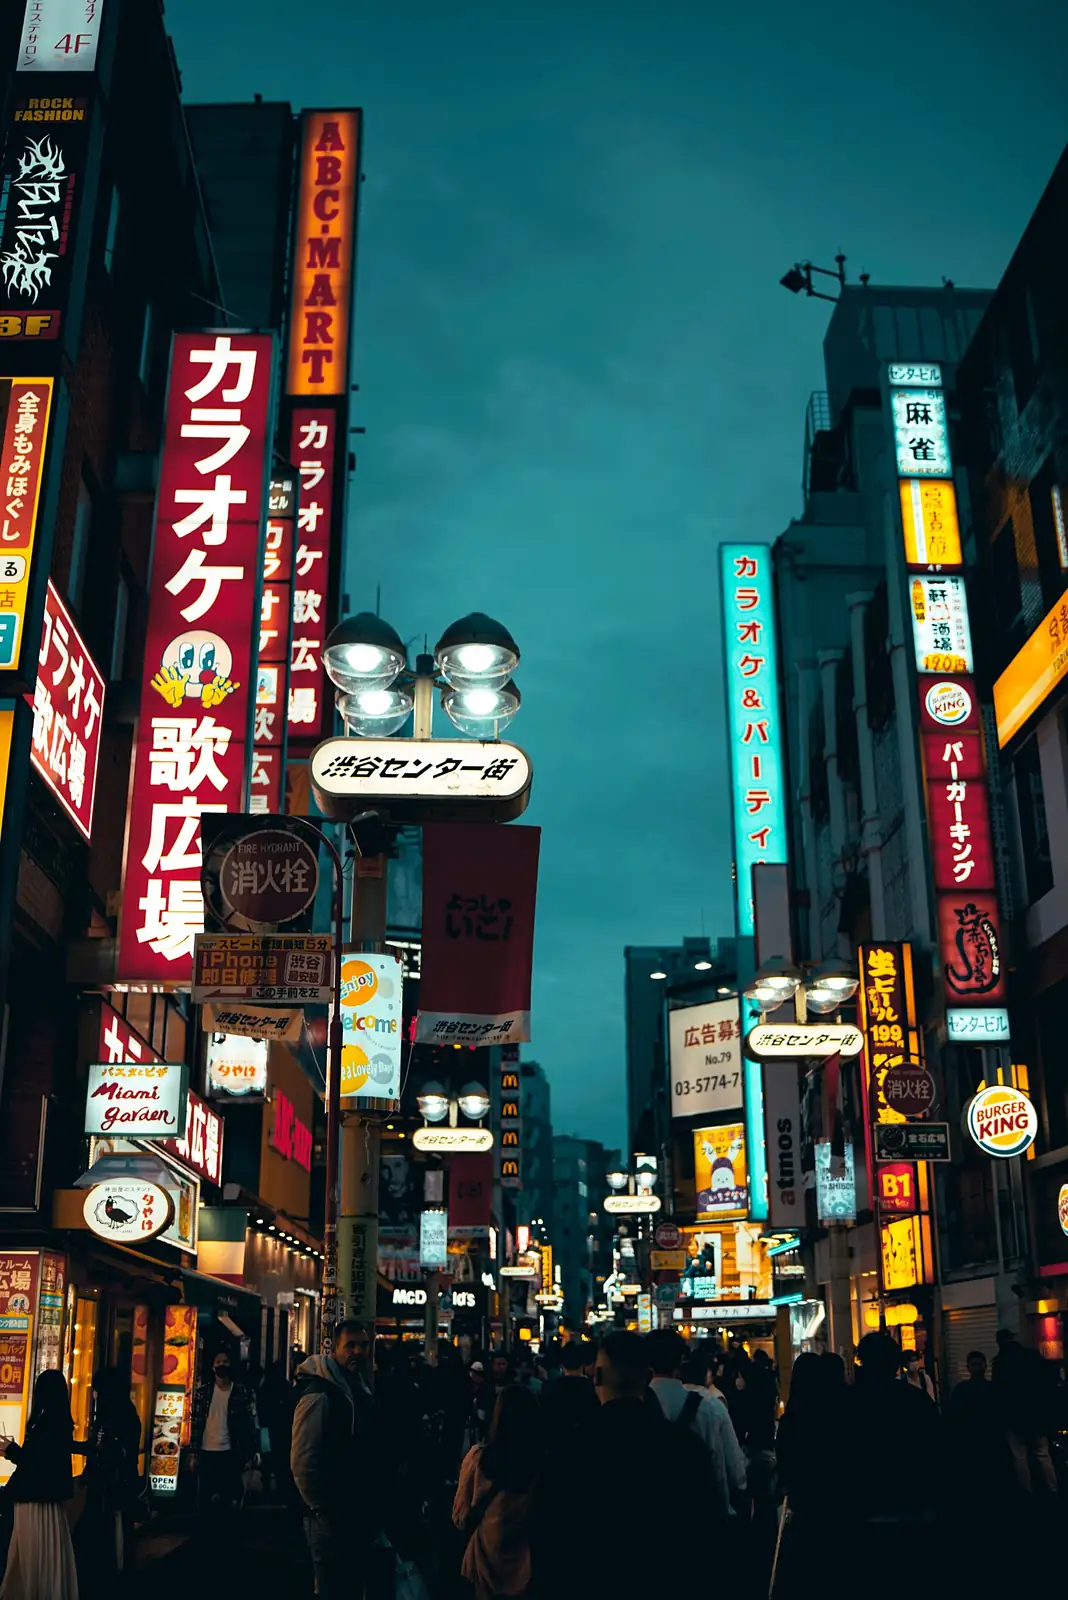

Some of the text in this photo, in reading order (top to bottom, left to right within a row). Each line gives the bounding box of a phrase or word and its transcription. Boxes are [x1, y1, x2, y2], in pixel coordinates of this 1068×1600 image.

[85, 0, 95, 23] 47
[54, 34, 92, 53] 4F
[29, 98, 73, 108] ROCK
[15, 110, 84, 121] FASHION
[0, 316, 51, 336] 3F
[890, 366, 940, 381] センタービル
[906, 402, 937, 461] 麻雀
[1, 391, 41, 542] 全身もみほぐし
[136, 337, 257, 961] カラオケ 歌広場
[934, 698, 965, 715] KING
[321, 755, 519, 781] 渋谷センター街
[942, 741, 976, 883] バーガーキング
[238, 841, 301, 854] FIRE HYDRANT
[230, 857, 310, 896] 消火栓
[202, 951, 278, 968] iPhone
[289, 953, 321, 970] 渋谷
[255, 987, 320, 999] この手前を左
[340, 971, 374, 999] Enjoy
[867, 948, 898, 1022] 生ビール
[215, 1011, 290, 1029] 渋谷センター街
[341, 1012, 397, 1034] elcome
[432, 1019, 514, 1035] 渋谷センター街
[948, 1015, 1008, 1033] センタービル
[755, 1033, 858, 1047] 渋谷センター街
[705, 1051, 732, 1066] No.79
[101, 1067, 168, 1078] パスタとピザ
[217, 1064, 257, 1077] 夕やけ
[90, 1082, 160, 1101] Miami
[675, 1071, 744, 1097] 03-5774-7
[886, 1079, 930, 1099] 消火栓
[976, 1101, 1026, 1123] BURGER
[978, 1113, 1029, 1141] KING
[776, 1117, 796, 1206] atmos
[881, 1172, 911, 1198] B1
[141, 1193, 155, 1231] 夕やけ
[392, 1288, 476, 1307] McDld's
[158, 1394, 183, 1402] パスタ
